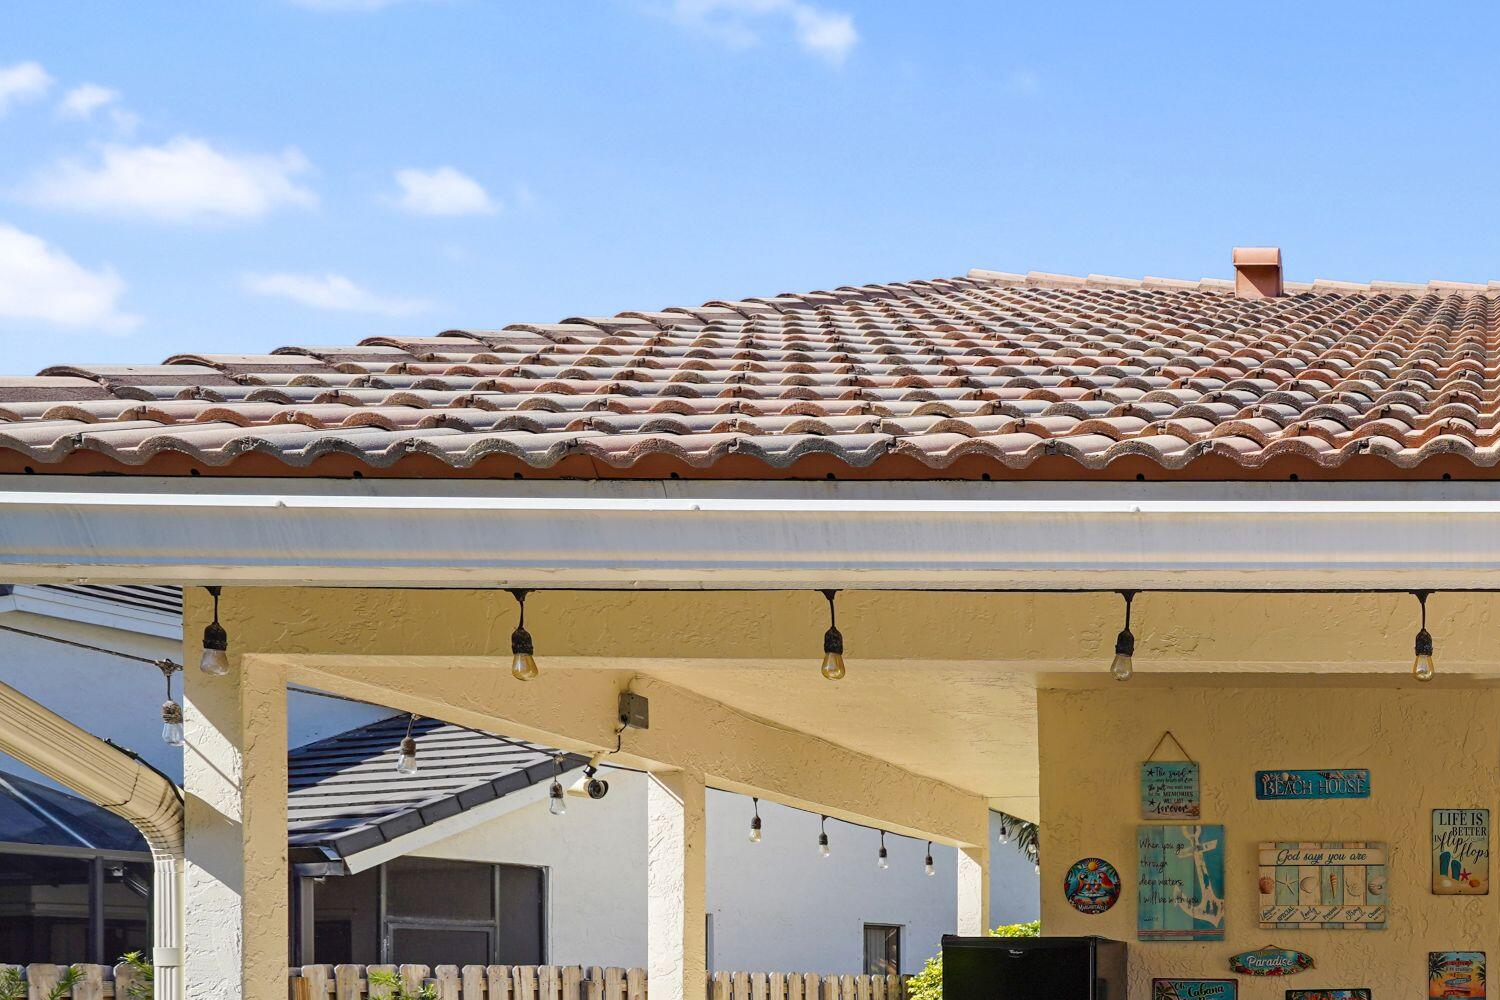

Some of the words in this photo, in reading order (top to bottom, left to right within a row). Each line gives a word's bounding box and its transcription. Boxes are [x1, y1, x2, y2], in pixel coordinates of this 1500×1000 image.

[1154, 766, 1166, 777] The
[1168, 767, 1187, 779] sand
[1263, 779, 1313, 796] BEACH
[1319, 778, 1367, 795] HOUSE
[1152, 802, 1189, 814] forever
[1440, 811, 1467, 826] LIFE
[1471, 811, 1483, 826] IS
[1452, 827, 1487, 837] BETTER
[1139, 834, 1159, 849] When
[1161, 842, 1174, 851] you
[1176, 843, 1185, 855] go
[1438, 831, 1466, 853] flip
[1275, 849, 1301, 865] God
[1302, 852, 1323, 864] says
[1324, 852, 1346, 865] you
[1349, 853, 1367, 861] are
[1457, 842, 1490, 864] flops
[1140, 857, 1168, 873] through
[1139, 874, 1157, 887] deep
[1144, 892, 1157, 905] will
[1158, 893, 1168, 904] be
[1168, 894, 1185, 904] with
[1276, 906, 1296, 922] SPECIAL
[1246, 955, 1294, 967] Paradise
[1187, 983, 1225, 998] Cabana
